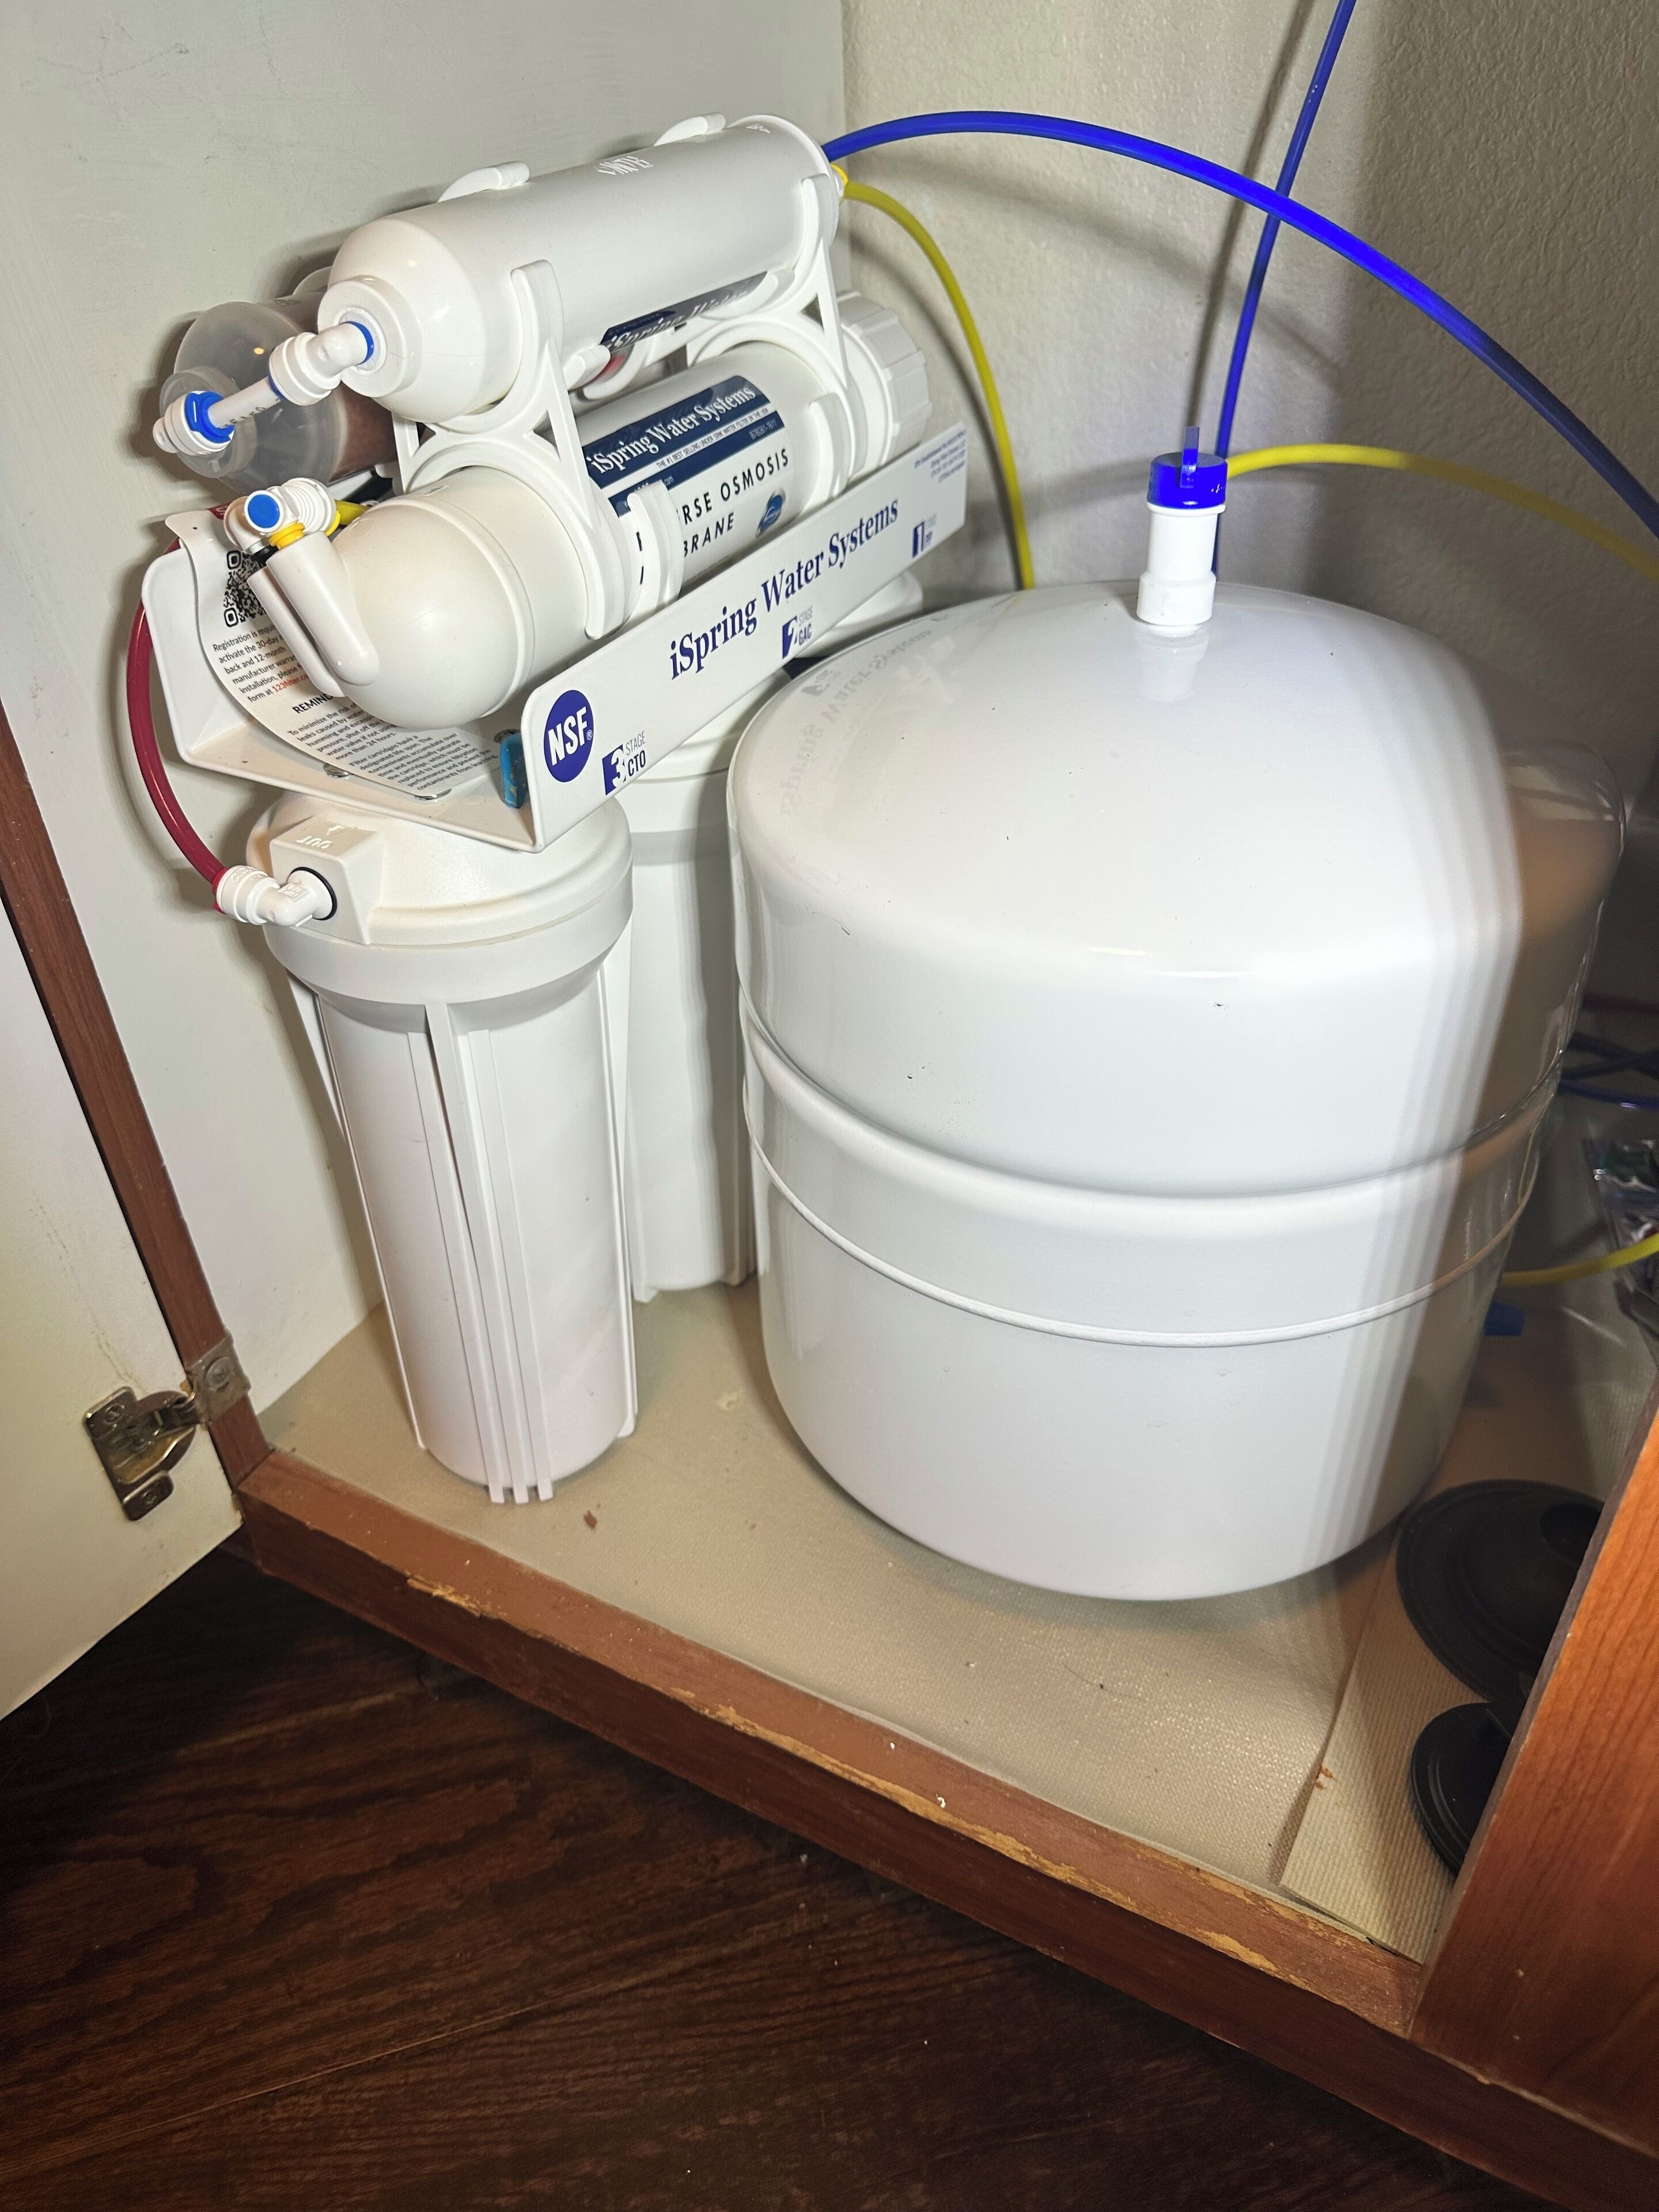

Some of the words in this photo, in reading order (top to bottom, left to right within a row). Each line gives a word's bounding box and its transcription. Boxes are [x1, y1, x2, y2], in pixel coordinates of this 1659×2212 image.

[586, 432, 660, 475] iSpring
[645, 414, 702, 444] Water
[694, 386, 757, 422] Systems
[656, 461, 667, 469] THE
[671, 451, 684, 461] BEST
[683, 443, 701, 456] SELLING
[720, 448, 789, 502] OSMOSIS
[683, 512, 734, 558] BRANE
[669, 597, 758, 680] iSpring
[760, 551, 825, 613] Water
[828, 498, 899, 569] Systems
[213, 633, 252, 652] Registration
[219, 649, 245, 664] activate
[245, 645, 257, 654] the
[257, 637, 279, 649] 30-day
[224, 662, 242, 675] back
[242, 657, 255, 668] and
[255, 645, 287, 662] 12-month
[232, 662, 276, 684] manufacturer
[238, 676, 279, 694] installation,
[278, 666, 299, 679] please
[248, 692, 266, 703] form
[272, 674, 310, 692] 123filter.co
[292, 694, 334, 714] REMIND
[297, 732, 316, 742] leaks
[316, 722, 340, 734] caused
[337, 717, 348, 725] by
[346, 710, 365, 720] water
[298, 717, 327, 732] minimize
[327, 712, 339, 721] the
[339, 706, 350, 714] risk
[346, 730, 361, 739] shut
[360, 725, 370, 733] off
[306, 731, 340, 747] humming
[338, 726, 351, 735] and
[325, 746, 346, 756] water
[345, 738, 363, 748] valve
[626, 730, 646, 756] STAGE
[335, 752, 354, 761] more
[352, 744, 369, 753] than
[349, 757, 368, 767] Filter
[368, 744, 399, 760] cartridges
[396, 737, 414, 746] have
[627, 749, 646, 777] CTO
